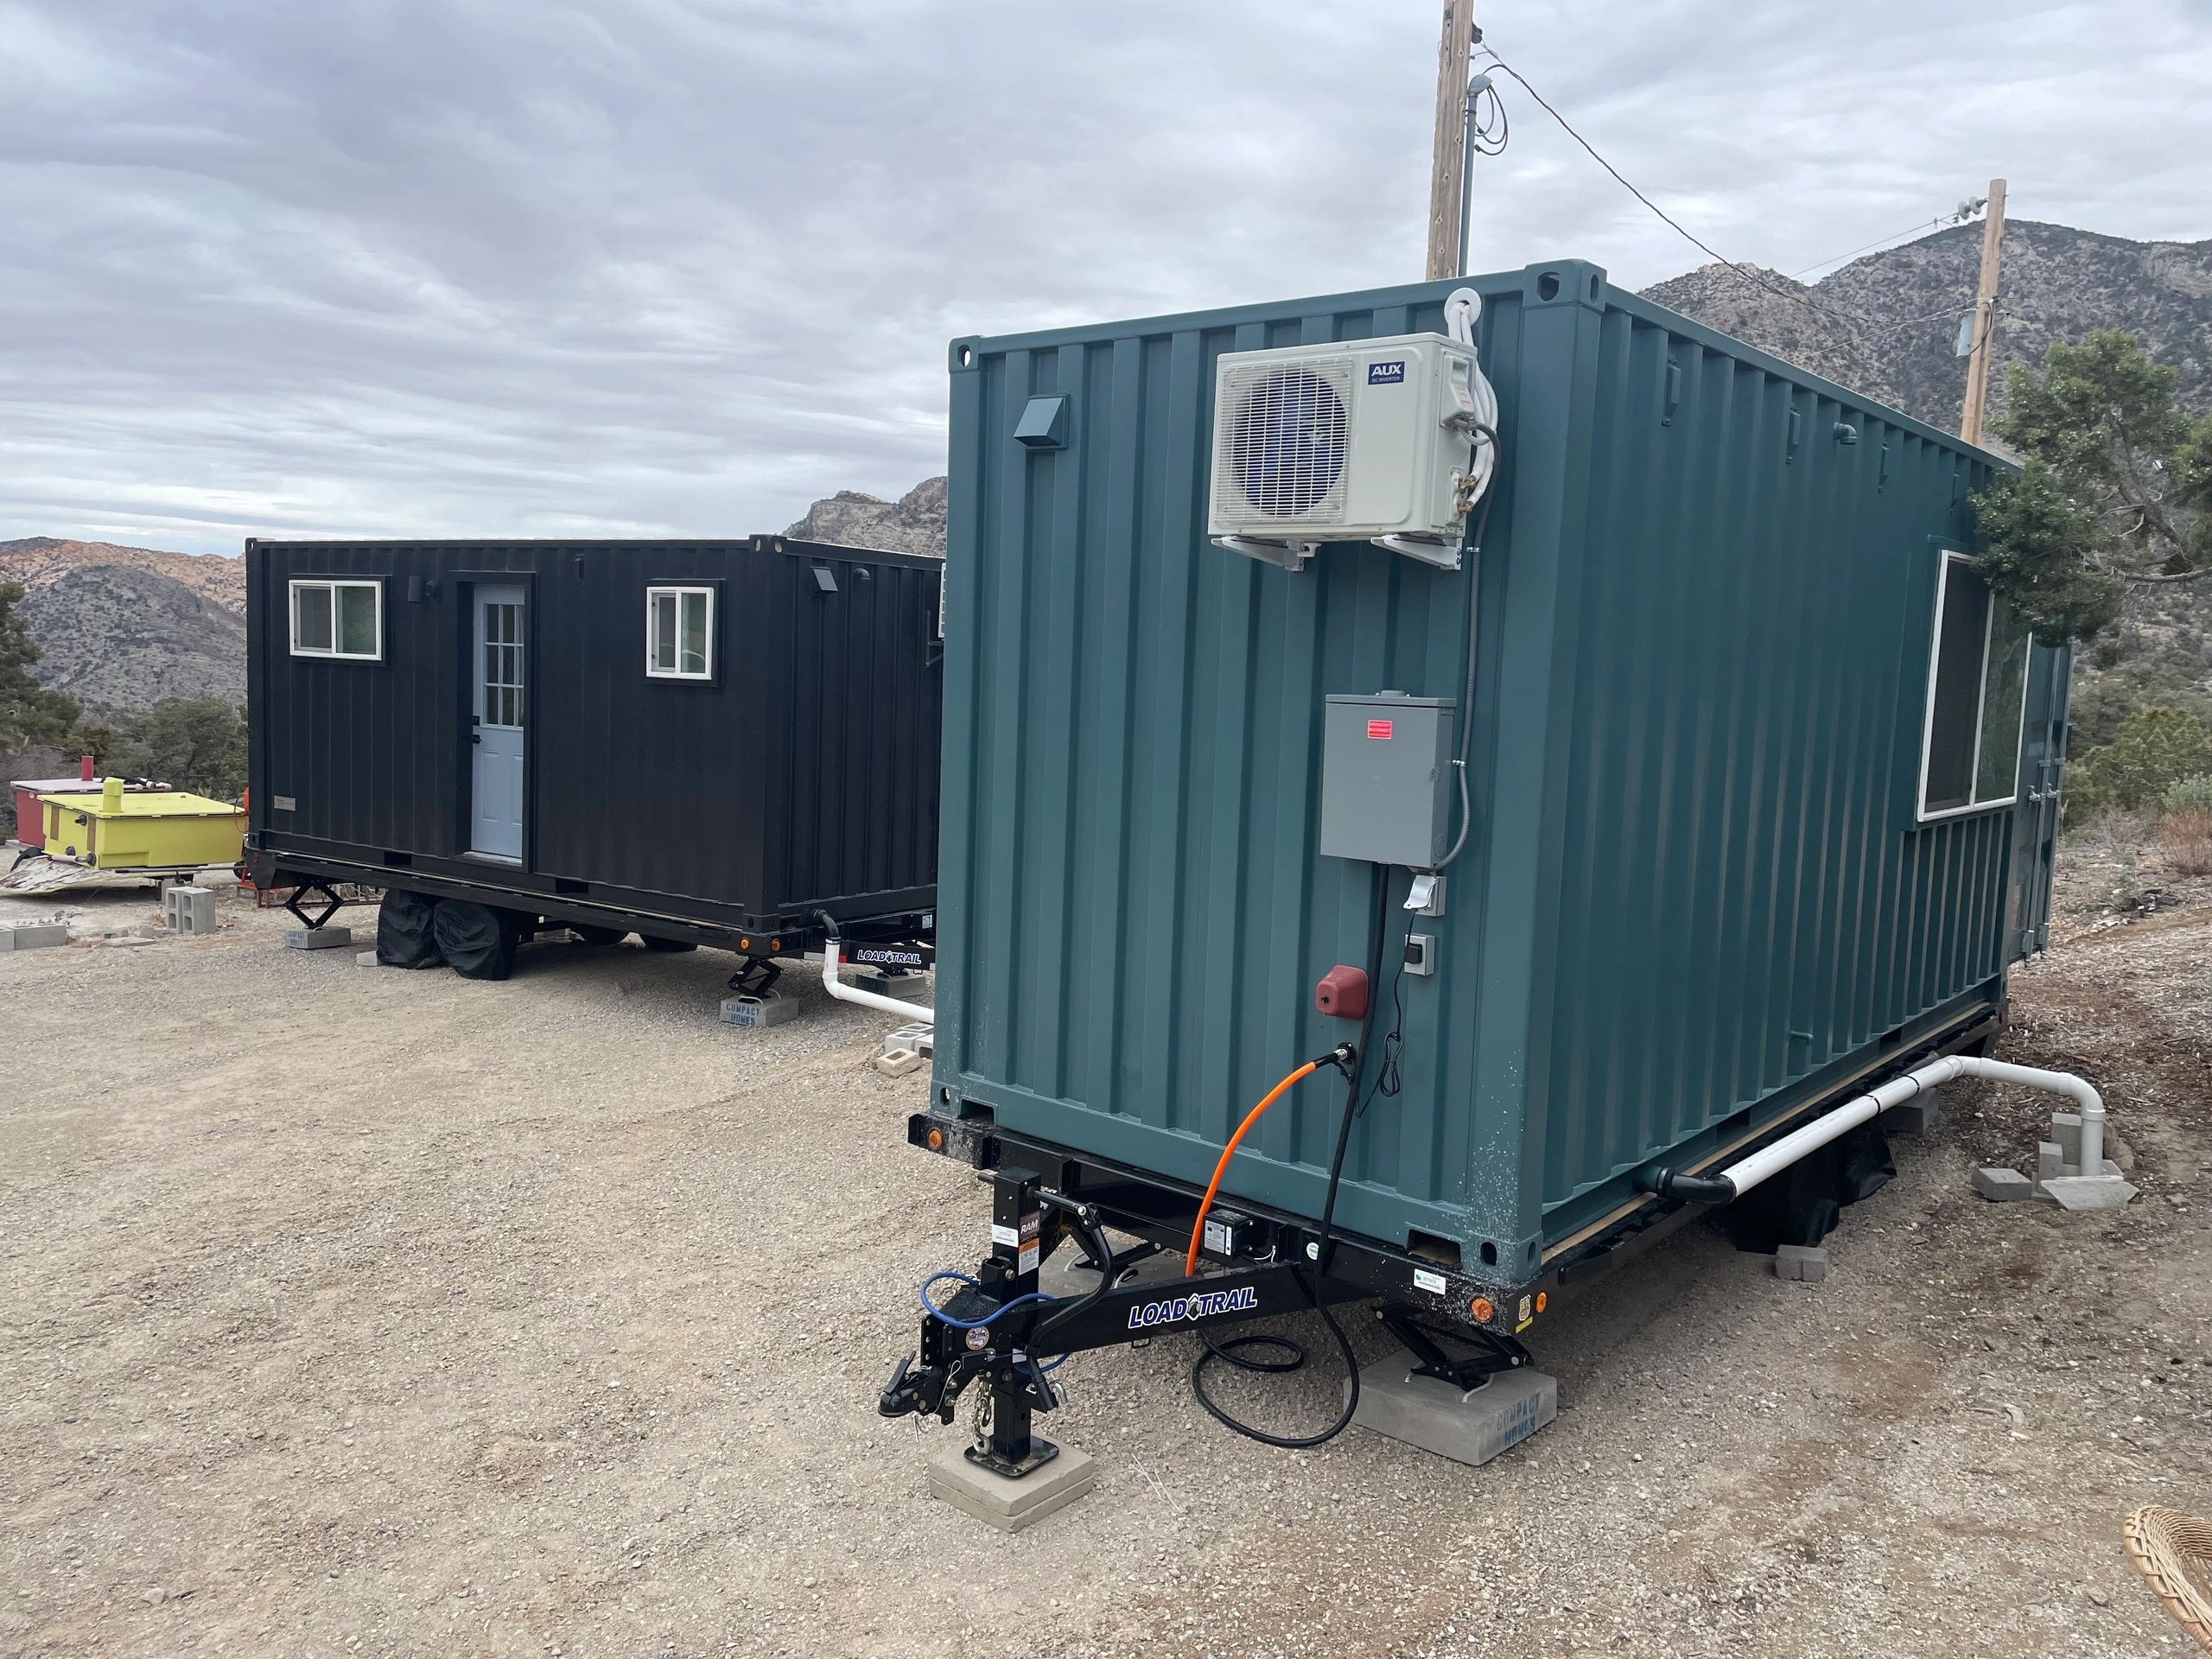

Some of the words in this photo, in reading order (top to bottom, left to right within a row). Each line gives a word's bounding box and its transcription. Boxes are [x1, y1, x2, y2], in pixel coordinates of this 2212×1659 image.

[1371, 364, 1402, 377] AUX
[857, 950, 887, 963] LOAD
[891, 952, 922, 965] TRAIL
[726, 1002, 760, 1016] COMPACT
[730, 1013, 756, 1027] HOMES
[1020, 1219, 1039, 1235] RAM
[1128, 1298, 1189, 1329] LOAD
[1198, 1287, 1258, 1317] TRAIL
[1504, 1415, 1536, 1446] HOMES
